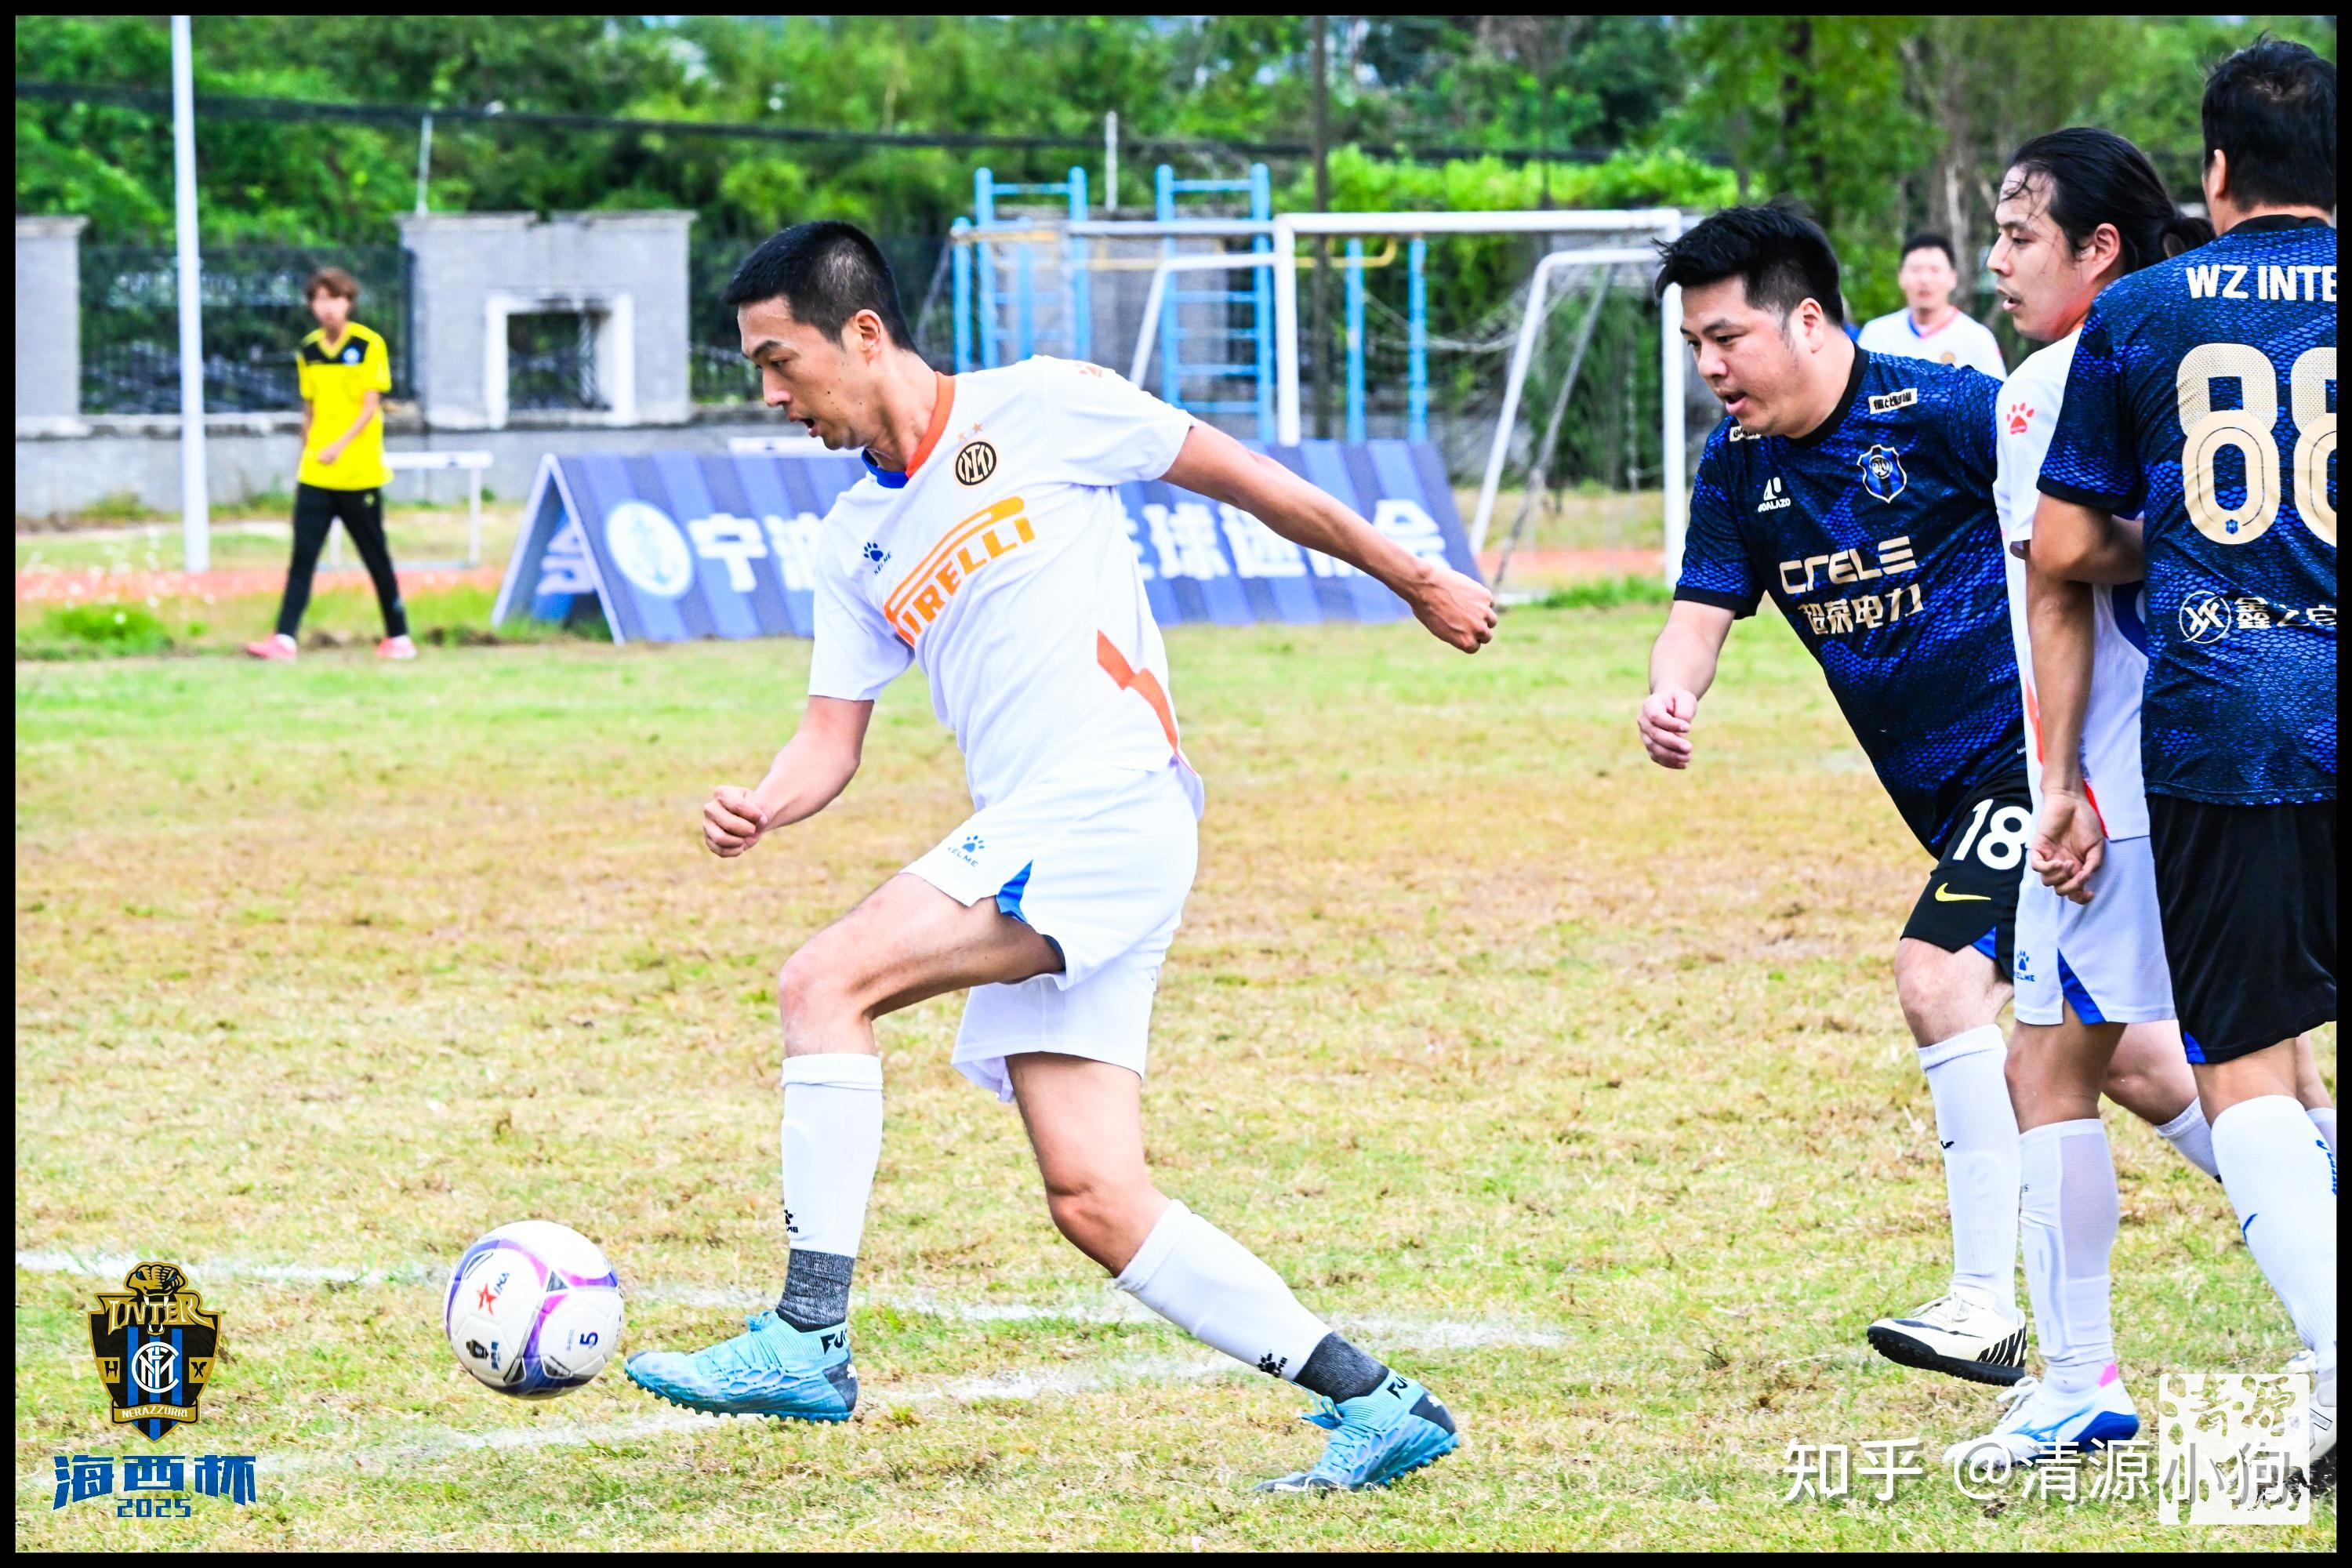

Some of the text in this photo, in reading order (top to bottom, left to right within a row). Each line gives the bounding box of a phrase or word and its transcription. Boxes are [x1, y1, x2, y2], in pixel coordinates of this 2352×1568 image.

[2186, 264, 2248, 299] WZ
[1952, 798, 2032, 870] 18
[579, 1331, 598, 1346] 5
